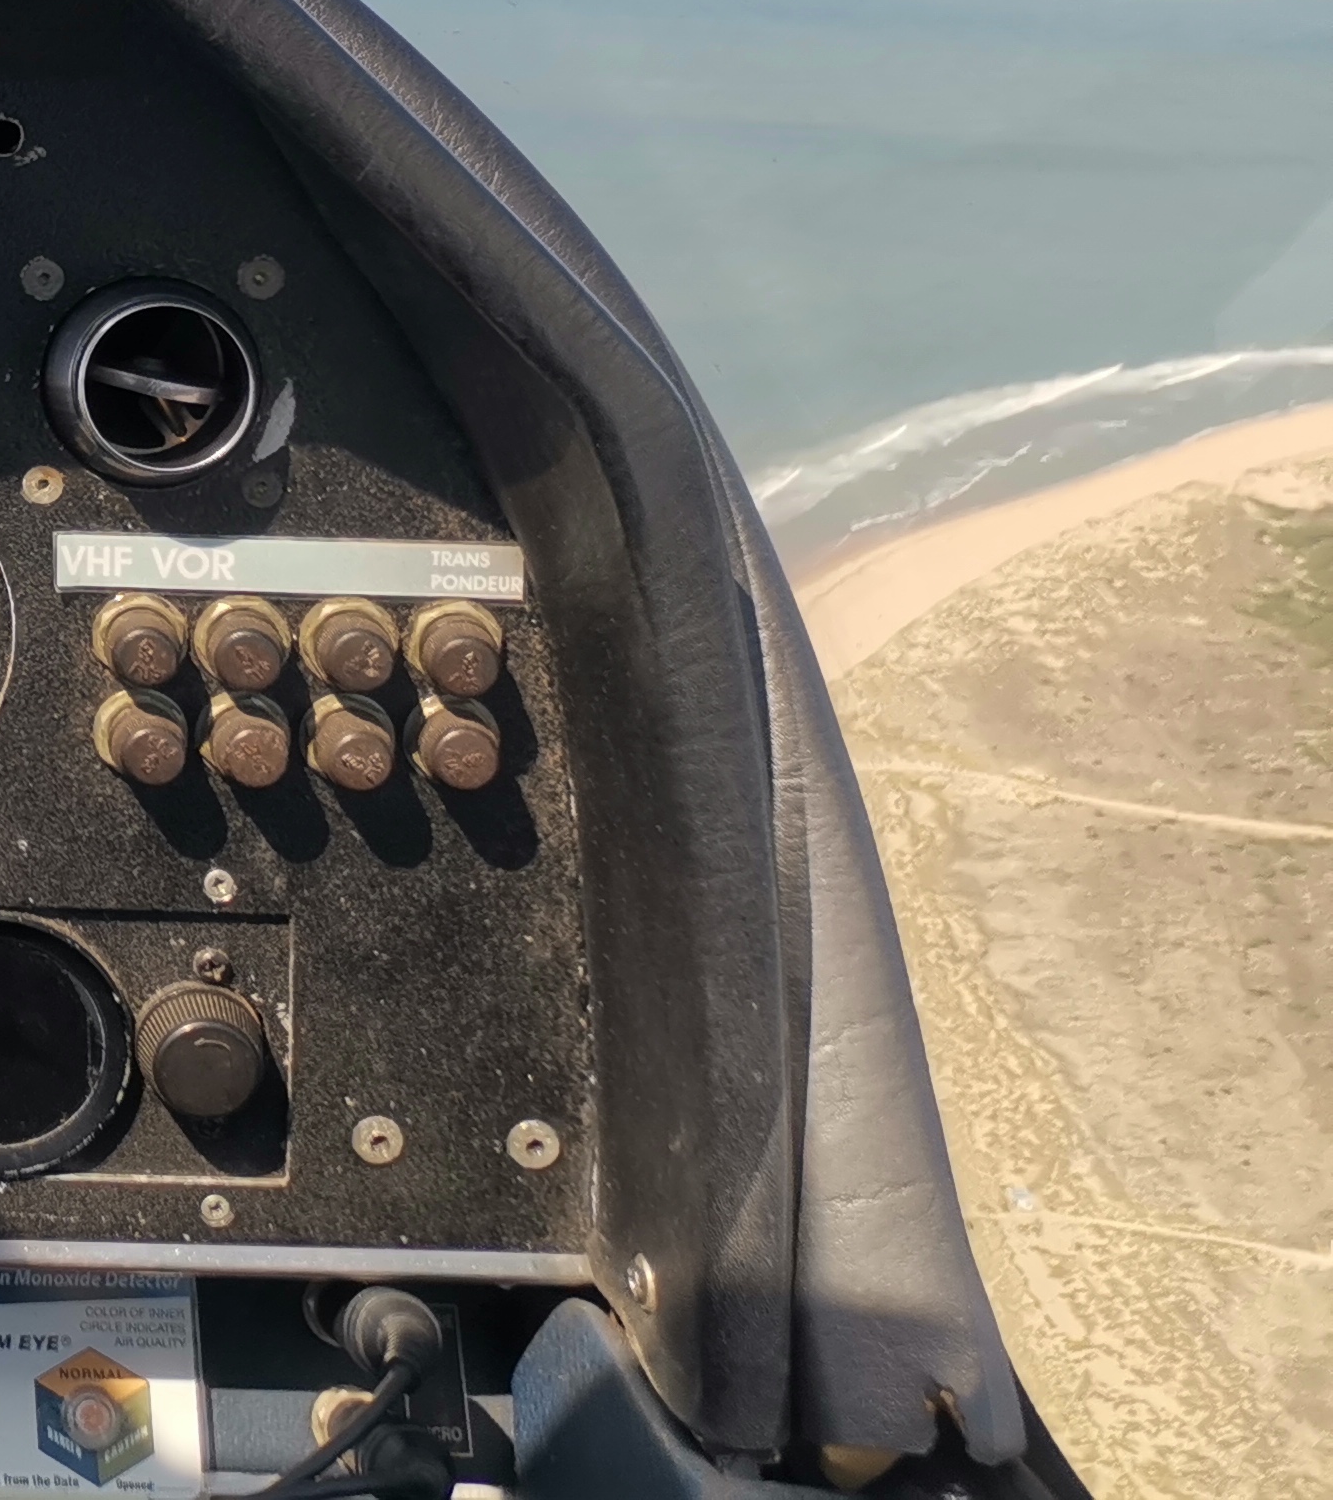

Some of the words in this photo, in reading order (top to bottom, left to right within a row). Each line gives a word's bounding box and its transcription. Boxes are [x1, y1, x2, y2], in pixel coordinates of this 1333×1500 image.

[60, 545, 133, 577] VHF
[151, 546, 235, 581] VOR
[431, 550, 491, 569] TRANS
[431, 574, 523, 594] PONDEUR
[13, 1271, 101, 1288] Monoxide
[105, 1270, 183, 1288] Detector
[126, 1321, 186, 1335] INDICATES
[136, 1336, 186, 1348] QUALITY
[59, 1367, 123, 1380] NORMAL
